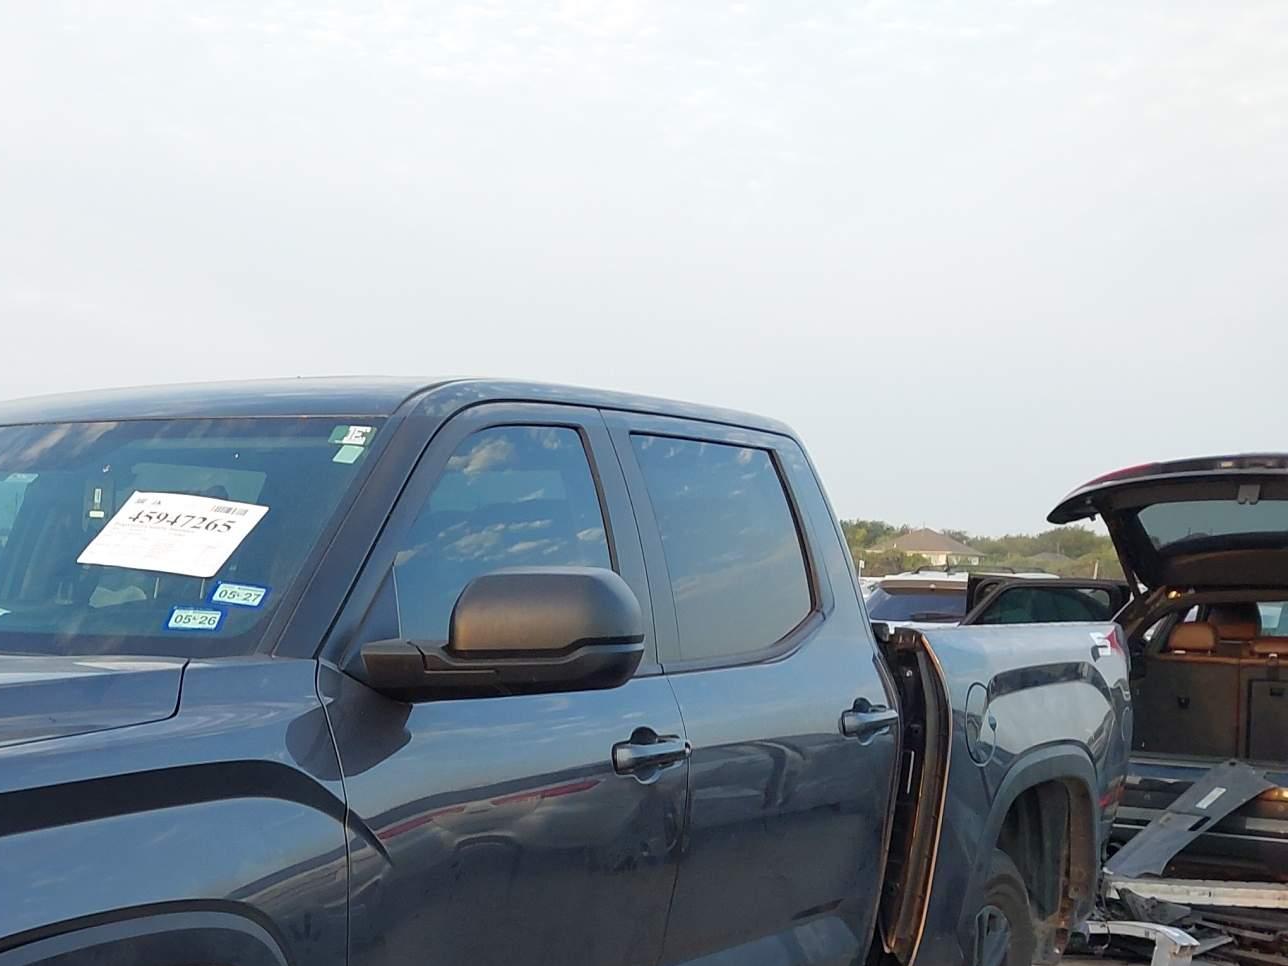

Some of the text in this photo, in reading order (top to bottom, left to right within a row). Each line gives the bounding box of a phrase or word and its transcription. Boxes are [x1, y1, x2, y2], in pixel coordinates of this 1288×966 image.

[128, 510, 237, 533] 45947265
[219, 589, 262, 603] 05 27
[174, 614, 217, 626] 05 26
